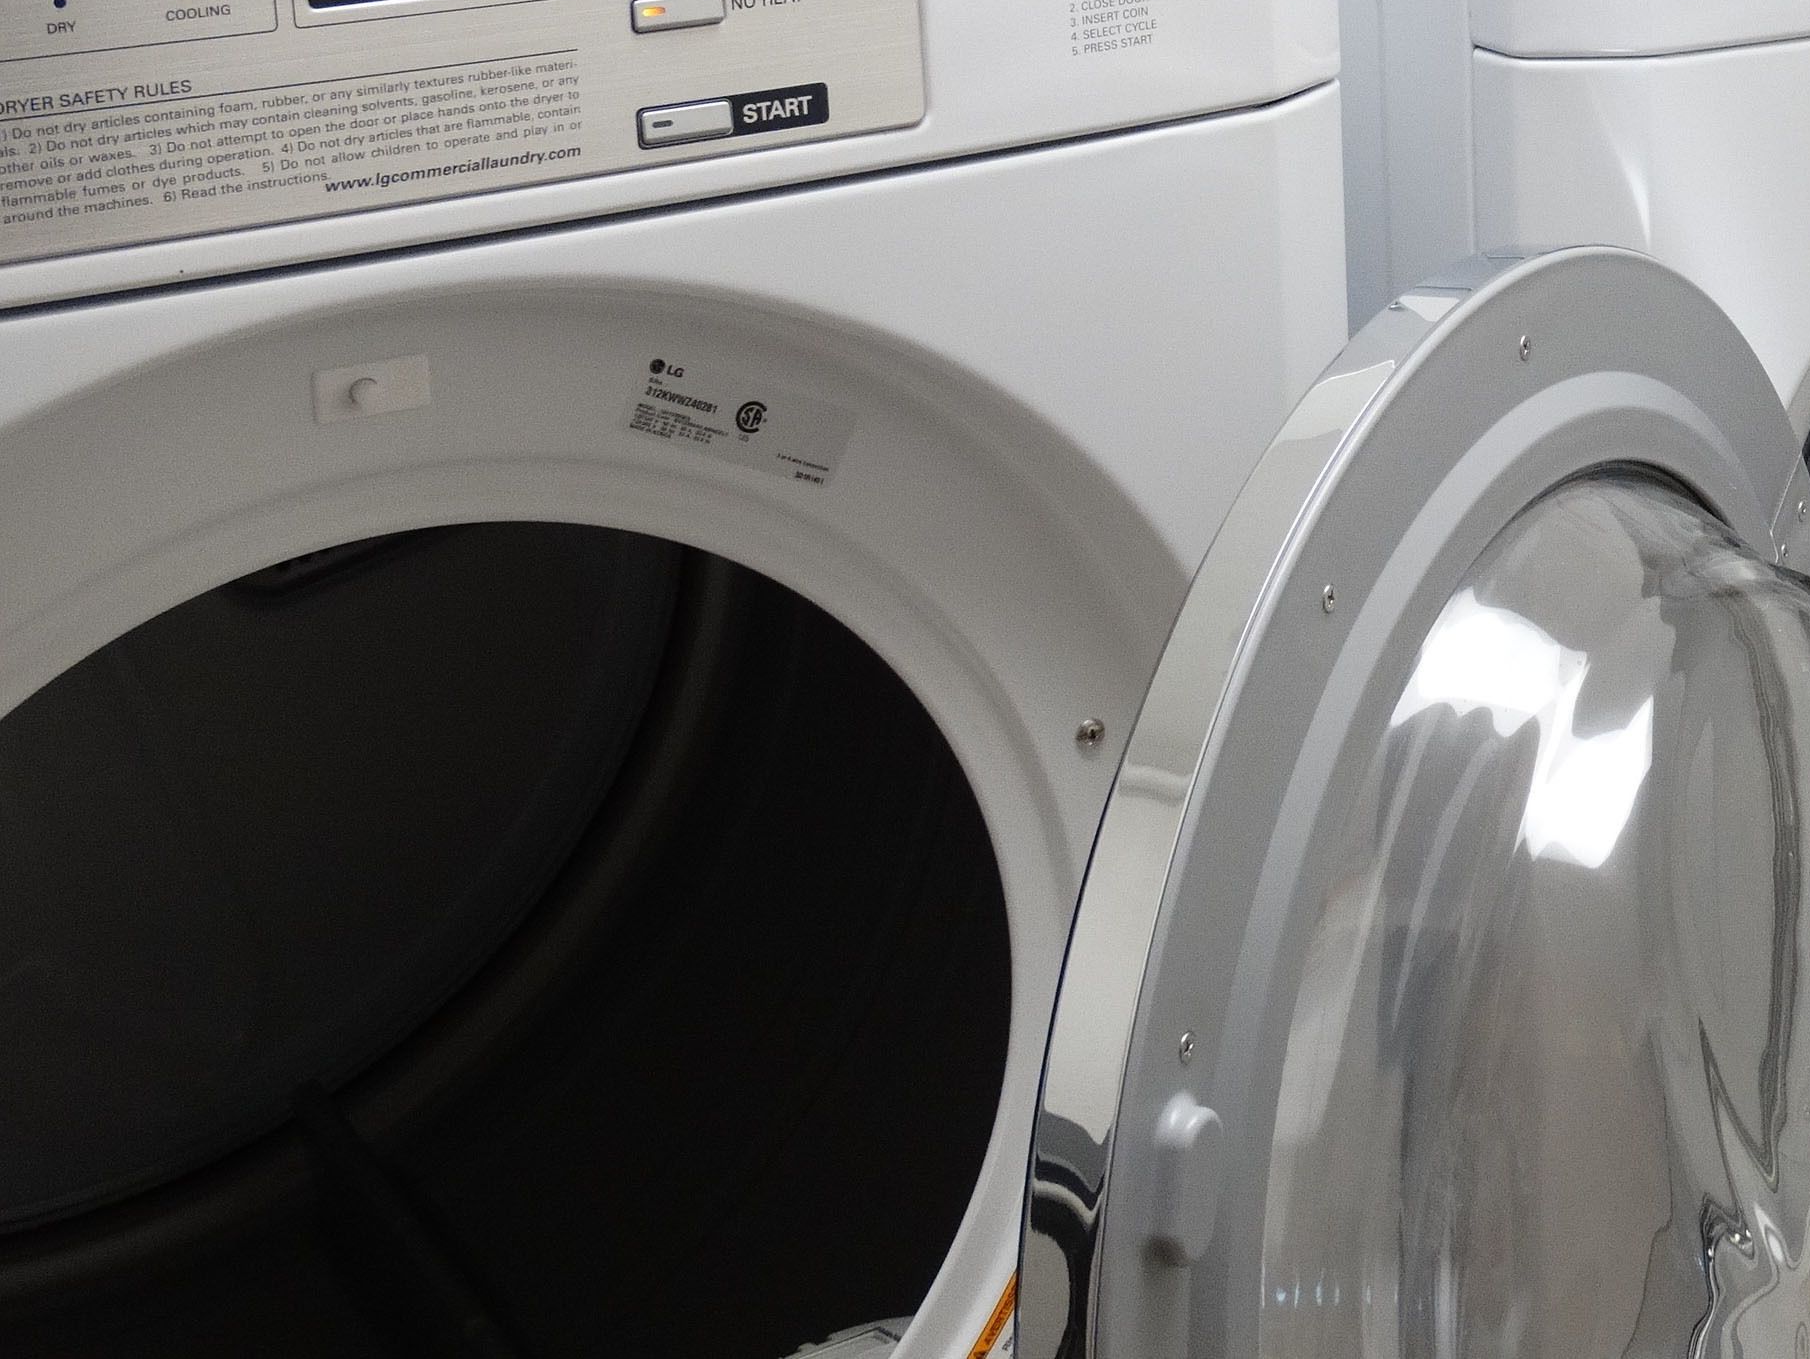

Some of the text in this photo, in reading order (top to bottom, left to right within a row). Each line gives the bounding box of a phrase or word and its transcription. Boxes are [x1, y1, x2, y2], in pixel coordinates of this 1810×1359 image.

[166, 4, 231, 22] COOLING
[1082, 11, 1120, 25] INSERT
[1123, 7, 1148, 19] COIN
[46, 21, 76, 35] DRY
[1083, 25, 1122, 40] SELECT
[1125, 19, 1157, 33] CYCLE
[1084, 40, 1118, 53] PRESS
[1121, 34, 1153, 48] START
[60, 87, 128, 108] SAFETY
[133, 80, 193, 98] RULES
[46, 140, 66, 151] Do
[70, 137, 93, 148] not
[96, 134, 119, 145] dry
[123, 128, 172, 142] articles
[175, 121, 215, 134] which
[219, 119, 248, 129] may
[251, 111, 300, 125] contain
[303, 104, 358, 119] cleaning
[541, 79, 554, 88] or
[558, 75, 579, 86] any
[743, 95, 812, 125] START
[2, 162, 34, 174] other
[39, 156, 65, 169] oils
[68, 156, 82, 166] or
[166, 141, 185, 153] Do
[190, 138, 212, 149] not
[216, 131, 267, 146] attempt
[271, 130, 284, 139] to
[288, 125, 320, 137] open
[324, 121, 345, 132] the
[349, 118, 379, 128] door
[383, 115, 396, 125] or
[401, 111, 433, 124] place
[437, 104, 475, 117] hands
[478, 101, 506, 111] onto
[509, 97, 529, 107] the
[533, 93, 563, 104] dryer
[567, 91, 579, 100] to
[2, 176, 53, 190] remove
[56, 174, 71, 183] or
[76, 168, 102, 181] add
[105, 163, 155, 177] clothes
[159, 156, 202, 170] during
[297, 140, 315, 152] Do
[319, 138, 340, 148] not
[343, 135, 365, 145] dry
[368, 129, 412, 142] articles
[415, 124, 440, 135] that
[443, 122, 462, 132] are
[537, 104, 581, 119] contain
[3, 188, 76, 206] flammable
[82, 183, 125, 196] fumes
[131, 180, 145, 190] or
[152, 176, 176, 188] dye
[280, 159, 298, 170] Do
[304, 155, 325, 166] not
[331, 151, 365, 163] allow
[370, 144, 420, 157] children
[425, 141, 438, 150] to
[443, 134, 490, 148] operate
[495, 128, 518, 140] and
[523, 125, 548, 138] play
[553, 123, 564, 132] in
[569, 120, 582, 130] or
[325, 147, 582, 193] www.lgcommerciallaundry.com
[667, 365, 684, 377] LG
